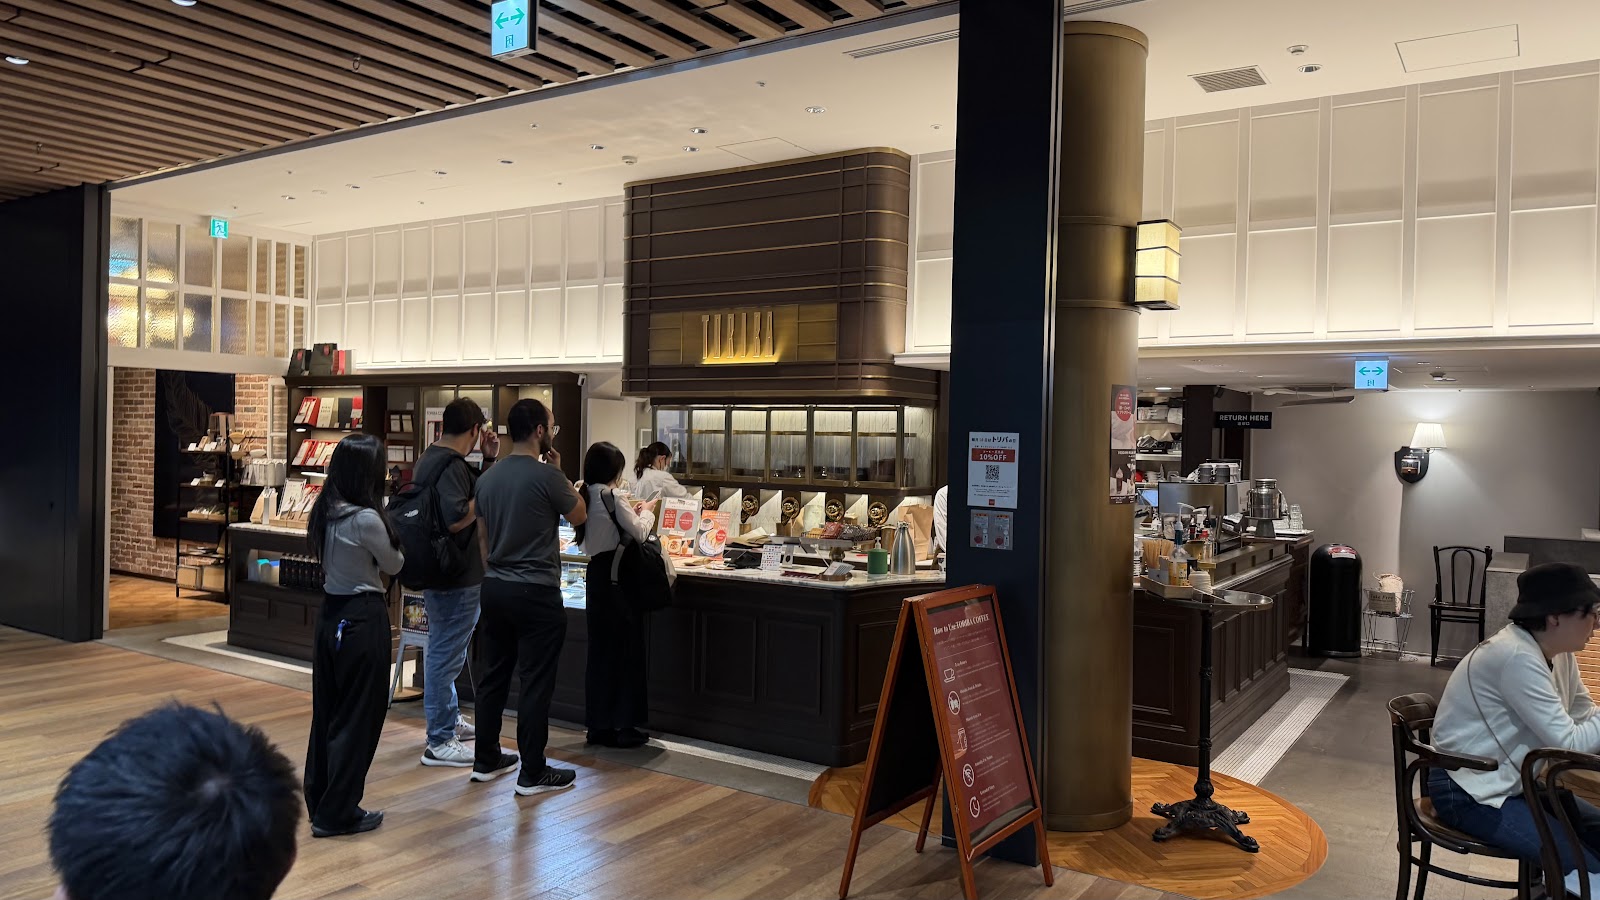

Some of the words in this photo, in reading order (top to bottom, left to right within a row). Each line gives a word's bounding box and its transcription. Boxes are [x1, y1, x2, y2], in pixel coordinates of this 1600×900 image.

[701, 311, 773, 359] TORIBA
[1249, 414, 1269, 422] HERE
[972, 613, 989, 625] COFFEE
